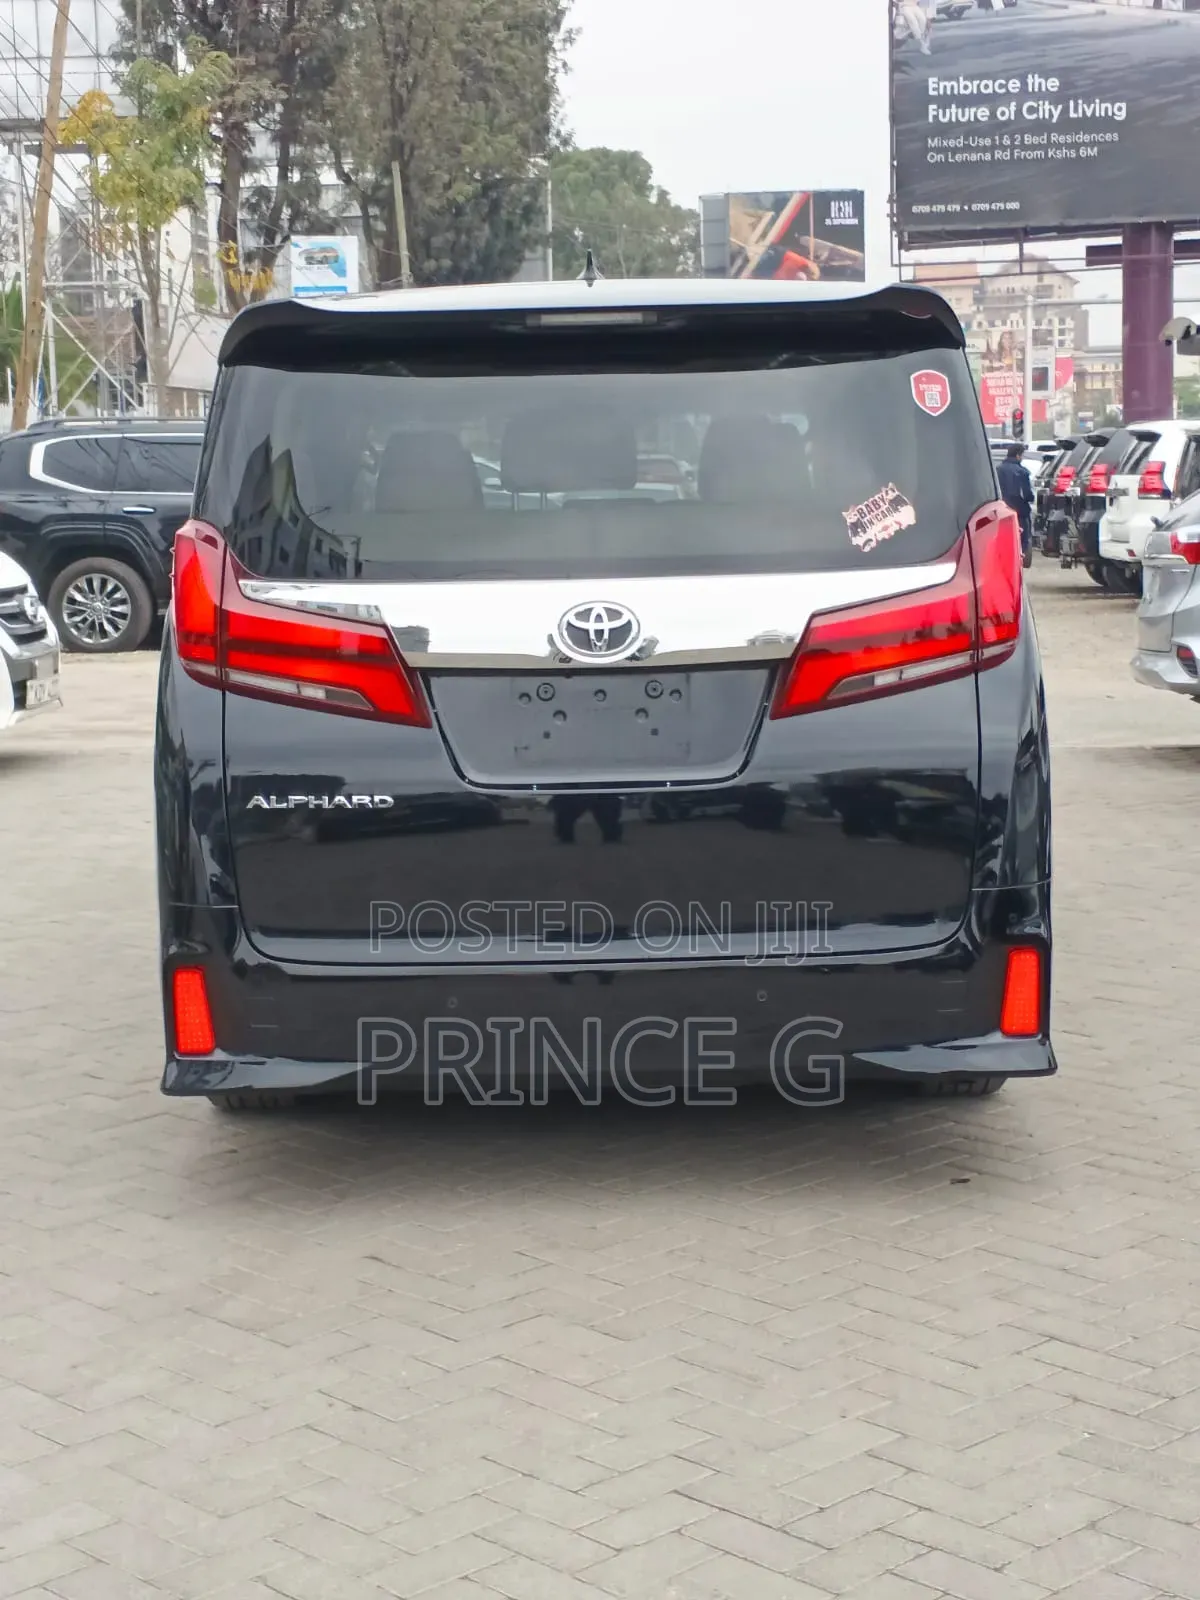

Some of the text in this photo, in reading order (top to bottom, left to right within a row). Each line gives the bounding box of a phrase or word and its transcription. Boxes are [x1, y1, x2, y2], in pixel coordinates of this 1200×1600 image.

[928, 74, 1060, 96] Embrace the
[928, 99, 1127, 123] Future of City Living
[927, 131, 1119, 149] Mixed-Use 1 & 2 Bed Residences
[927, 146, 1098, 164] On Lenana Rd From Kshs 6M
[856, 494, 887, 519] BABY
[863, 517, 875, 530] IN
[246, 795, 395, 809] ALPHARD
